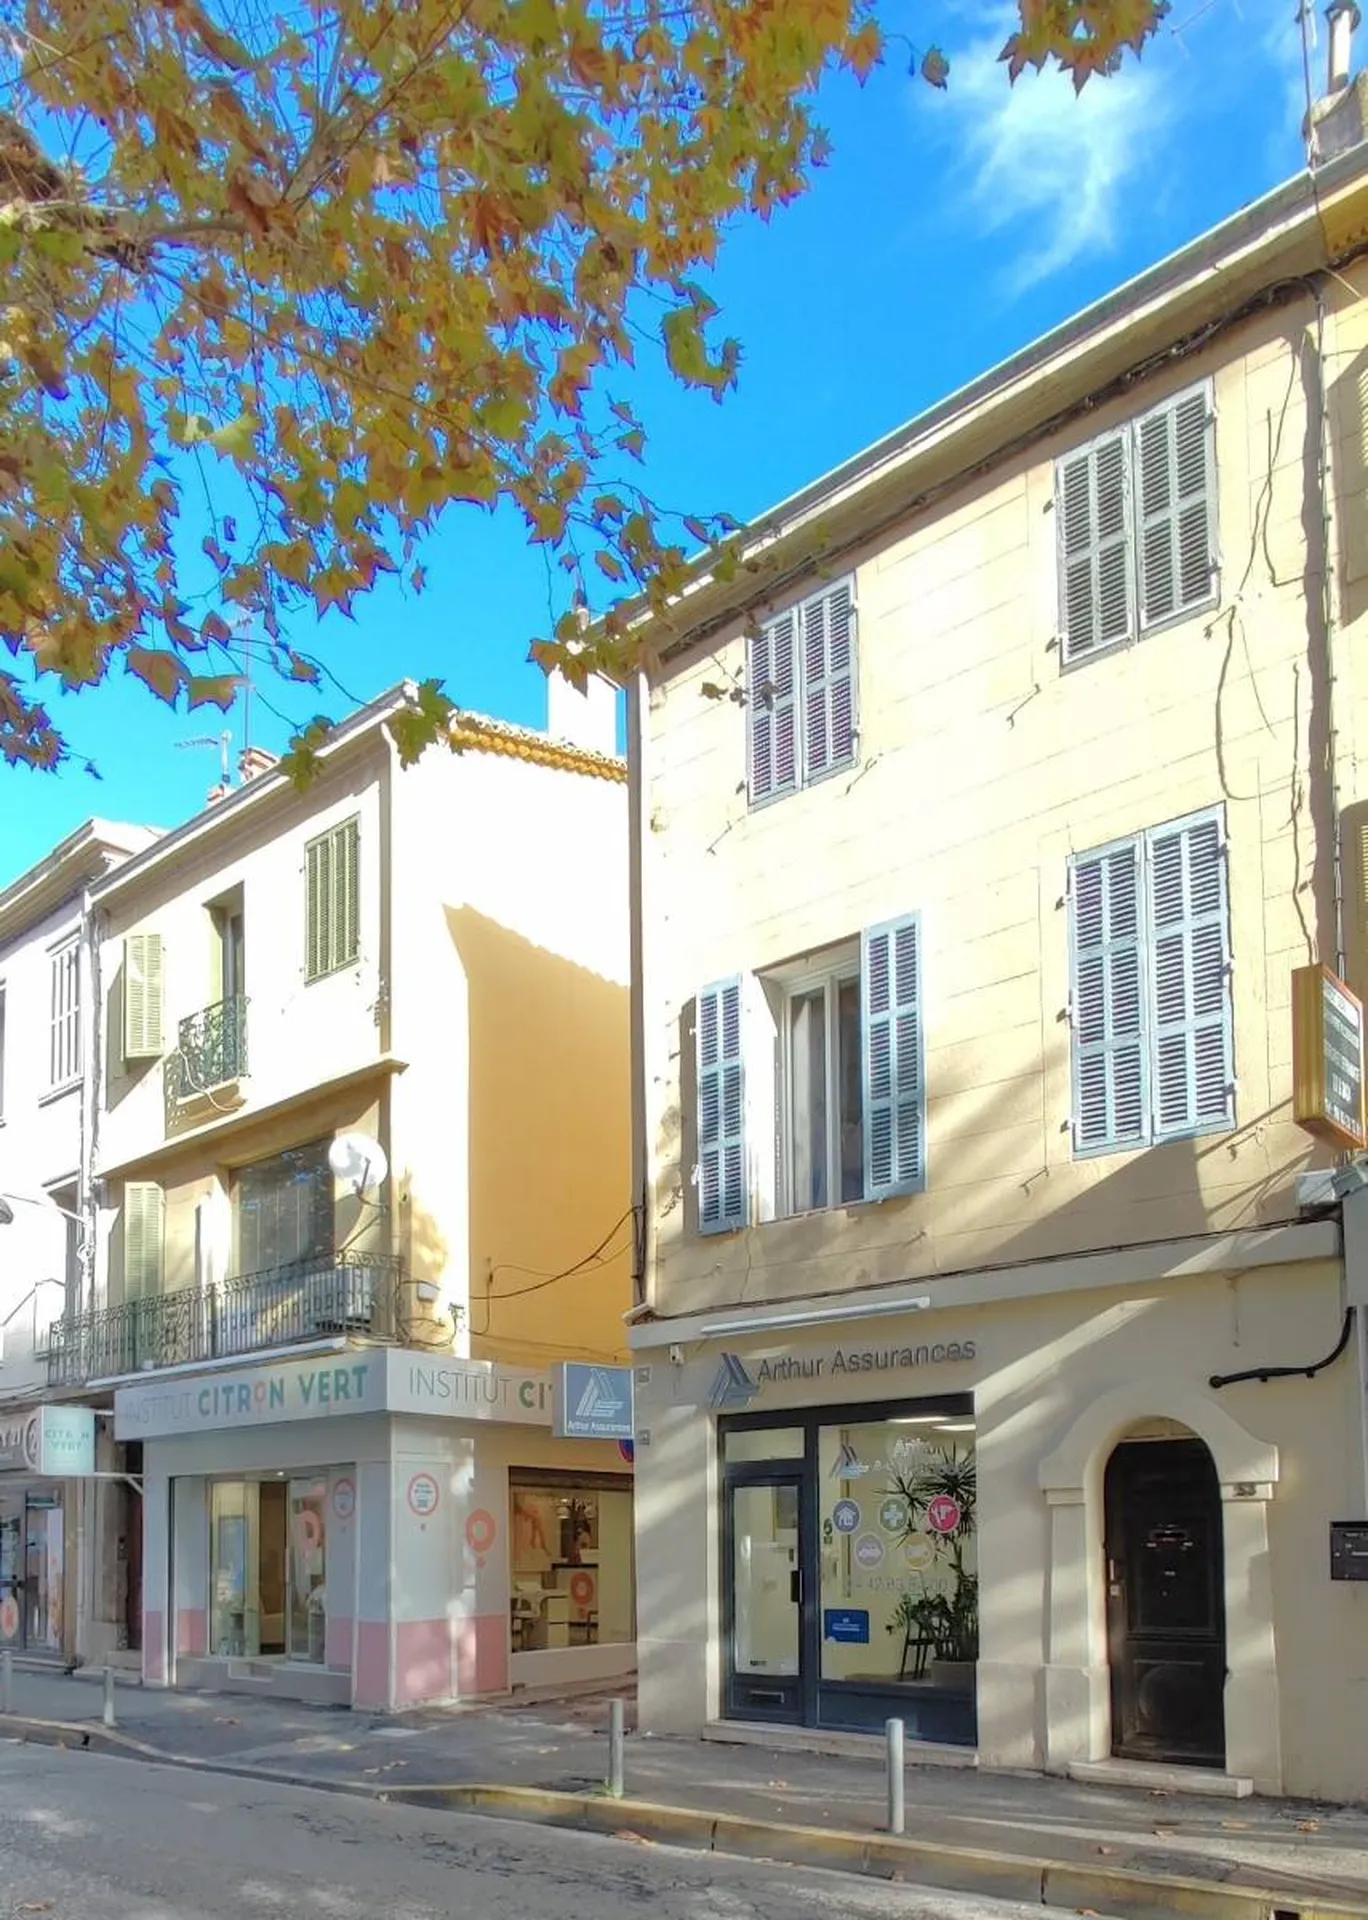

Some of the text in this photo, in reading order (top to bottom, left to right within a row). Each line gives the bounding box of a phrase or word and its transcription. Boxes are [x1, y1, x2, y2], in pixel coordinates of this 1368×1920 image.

[757, 1339, 977, 1382] Arthur Assurances
[198, 1376, 286, 1417] CITRON
[298, 1365, 370, 1405] VERT
[409, 1366, 514, 1406] INSTITUT
